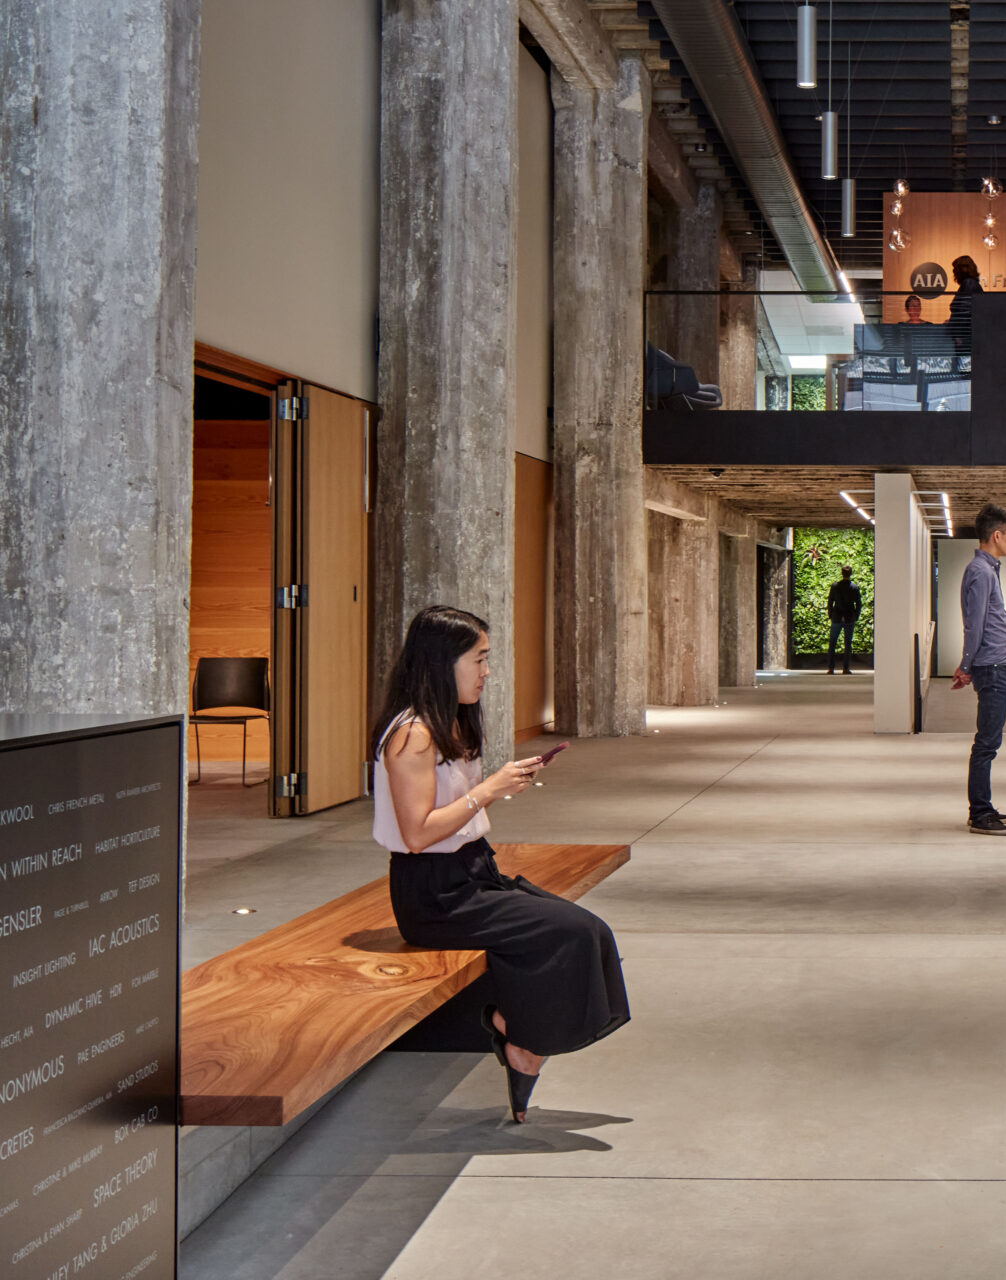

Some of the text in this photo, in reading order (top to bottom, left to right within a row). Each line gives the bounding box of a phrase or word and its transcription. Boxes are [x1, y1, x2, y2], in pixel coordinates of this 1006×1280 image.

[913, 273, 945, 288] AIA
[48, 801, 65, 815] CHRIS
[66, 796, 88, 811] FRENCH
[95, 825, 160, 854] HABITAT HORTICULTURE
[11, 852, 48, 878] WITHIN
[52, 842, 82, 867] REACH
[138, 873, 160, 890] DESIGN
[89, 913, 160, 958] IAC ACOUSTICS
[13, 952, 76, 988] INSIGHT LIGHTING
[45, 989, 103, 1029] DYNAMIC HIVE
[91, 1030, 125, 1058] ENGINEERS
[117, 1059, 159, 1093] SAND STUDIOS
[114, 1105, 159, 1145] BOX CAB CO
[0, 1126, 34, 1160] CRETES
[32, 1169, 61, 1196] CHRISTINE
[93, 1147, 158, 1208] SPACE THEORY
[12, 1236, 42, 1265] CHRISTINA
[49, 1221, 65, 1239] EVAN
[72, 1241, 98, 1274] TANG
[101, 1235, 107, 1253] &
[110, 1212, 140, 1245] GLORIA
[142, 1197, 158, 1223] ZHU
